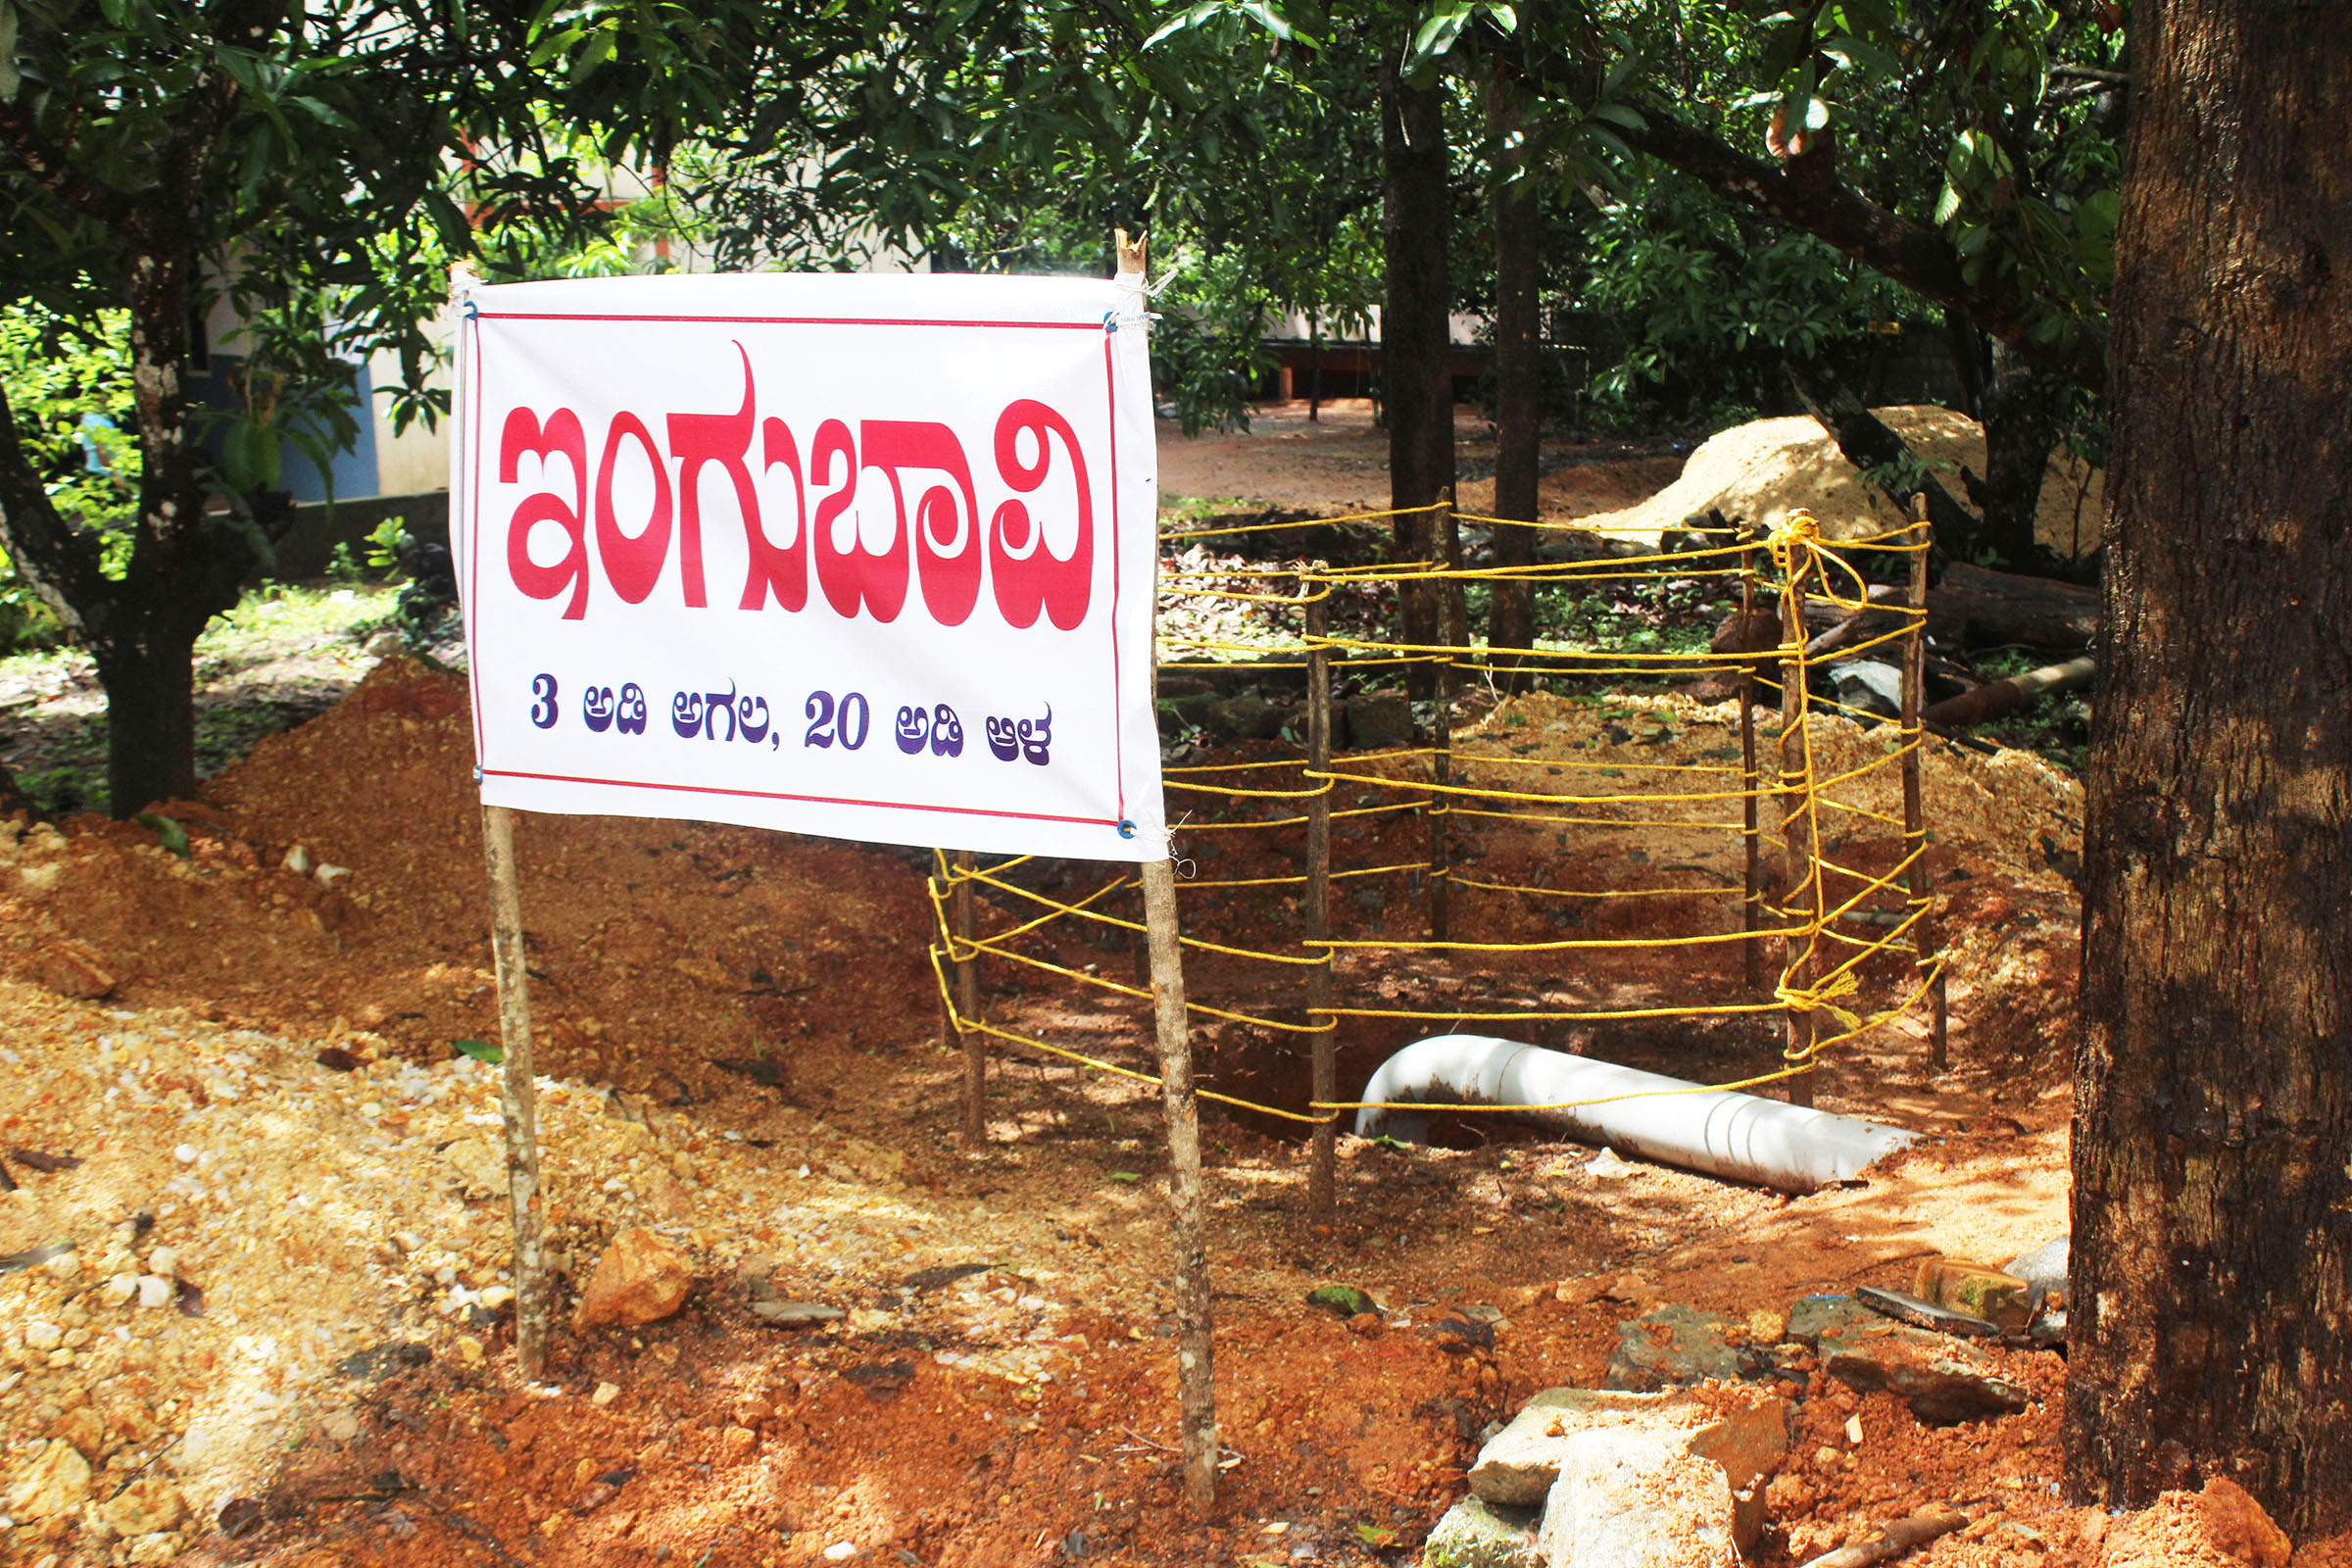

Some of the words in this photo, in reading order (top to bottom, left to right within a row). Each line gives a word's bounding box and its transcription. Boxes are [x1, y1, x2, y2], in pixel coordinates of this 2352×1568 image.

[500, 339, 1094, 632] ಇಂಗುಬಾವಿ
[531, 672, 560, 730] 3
[583, 682, 648, 736] ಅಡಿ
[671, 677, 780, 752] ಅಗಲ,
[804, 690, 870, 751] 20
[895, 703, 964, 759] ಅಡಿ
[985, 701, 1053, 766] ಆಳ
